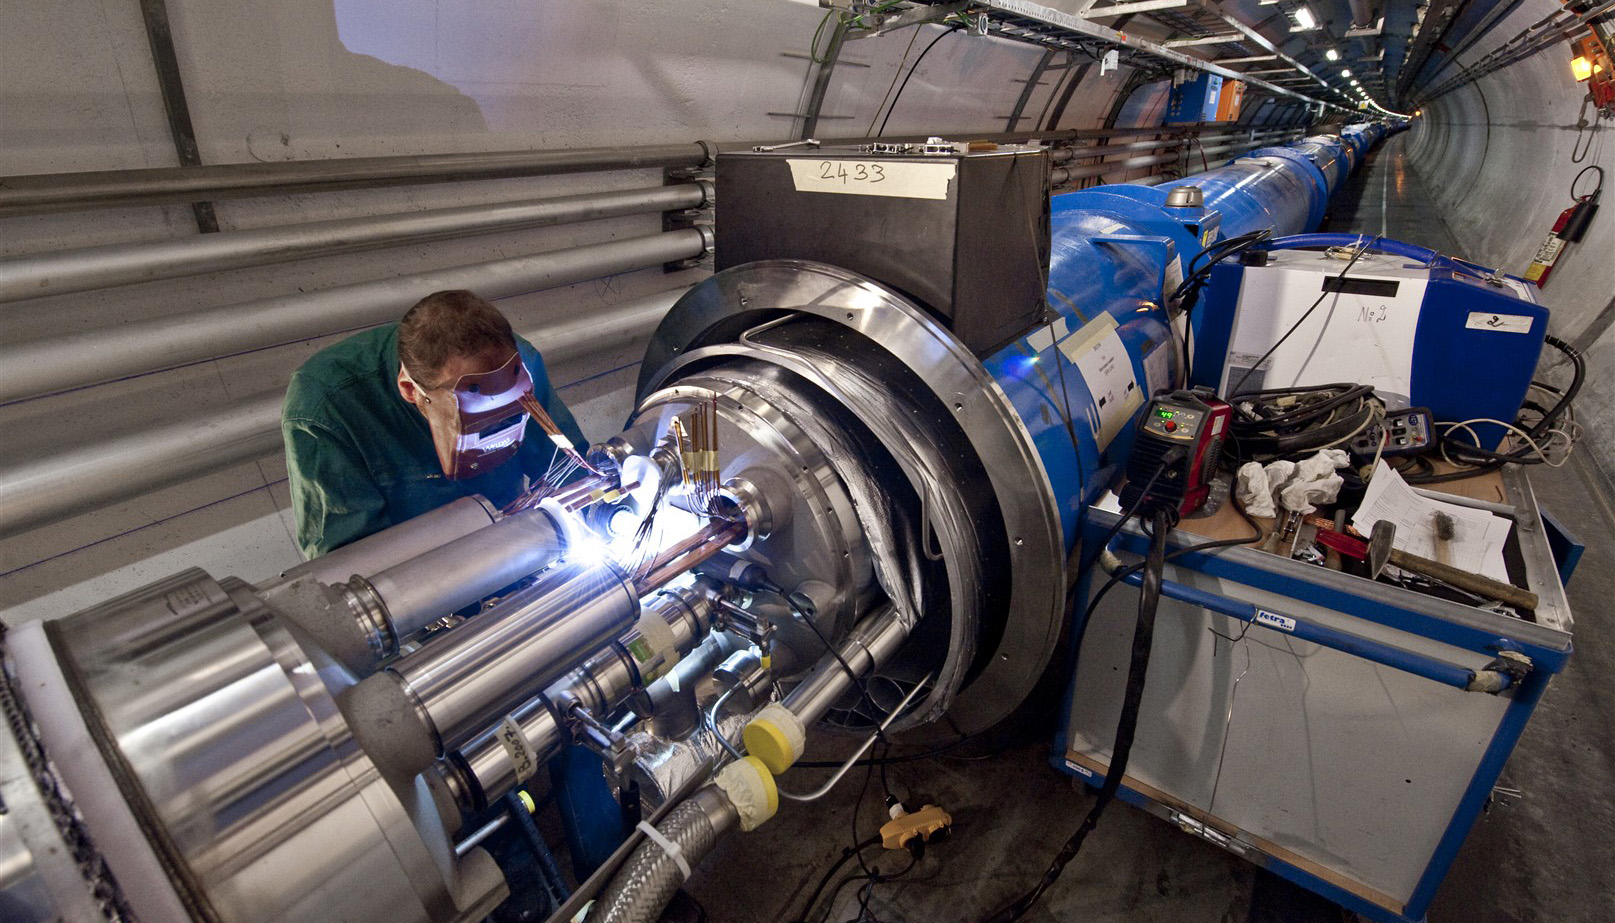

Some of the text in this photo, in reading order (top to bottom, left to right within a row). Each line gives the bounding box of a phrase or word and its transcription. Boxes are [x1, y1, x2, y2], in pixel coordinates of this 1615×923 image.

[820, 161, 886, 185] 2433
[1161, 411, 1173, 419] 49
[1259, 611, 1285, 624] fetra
